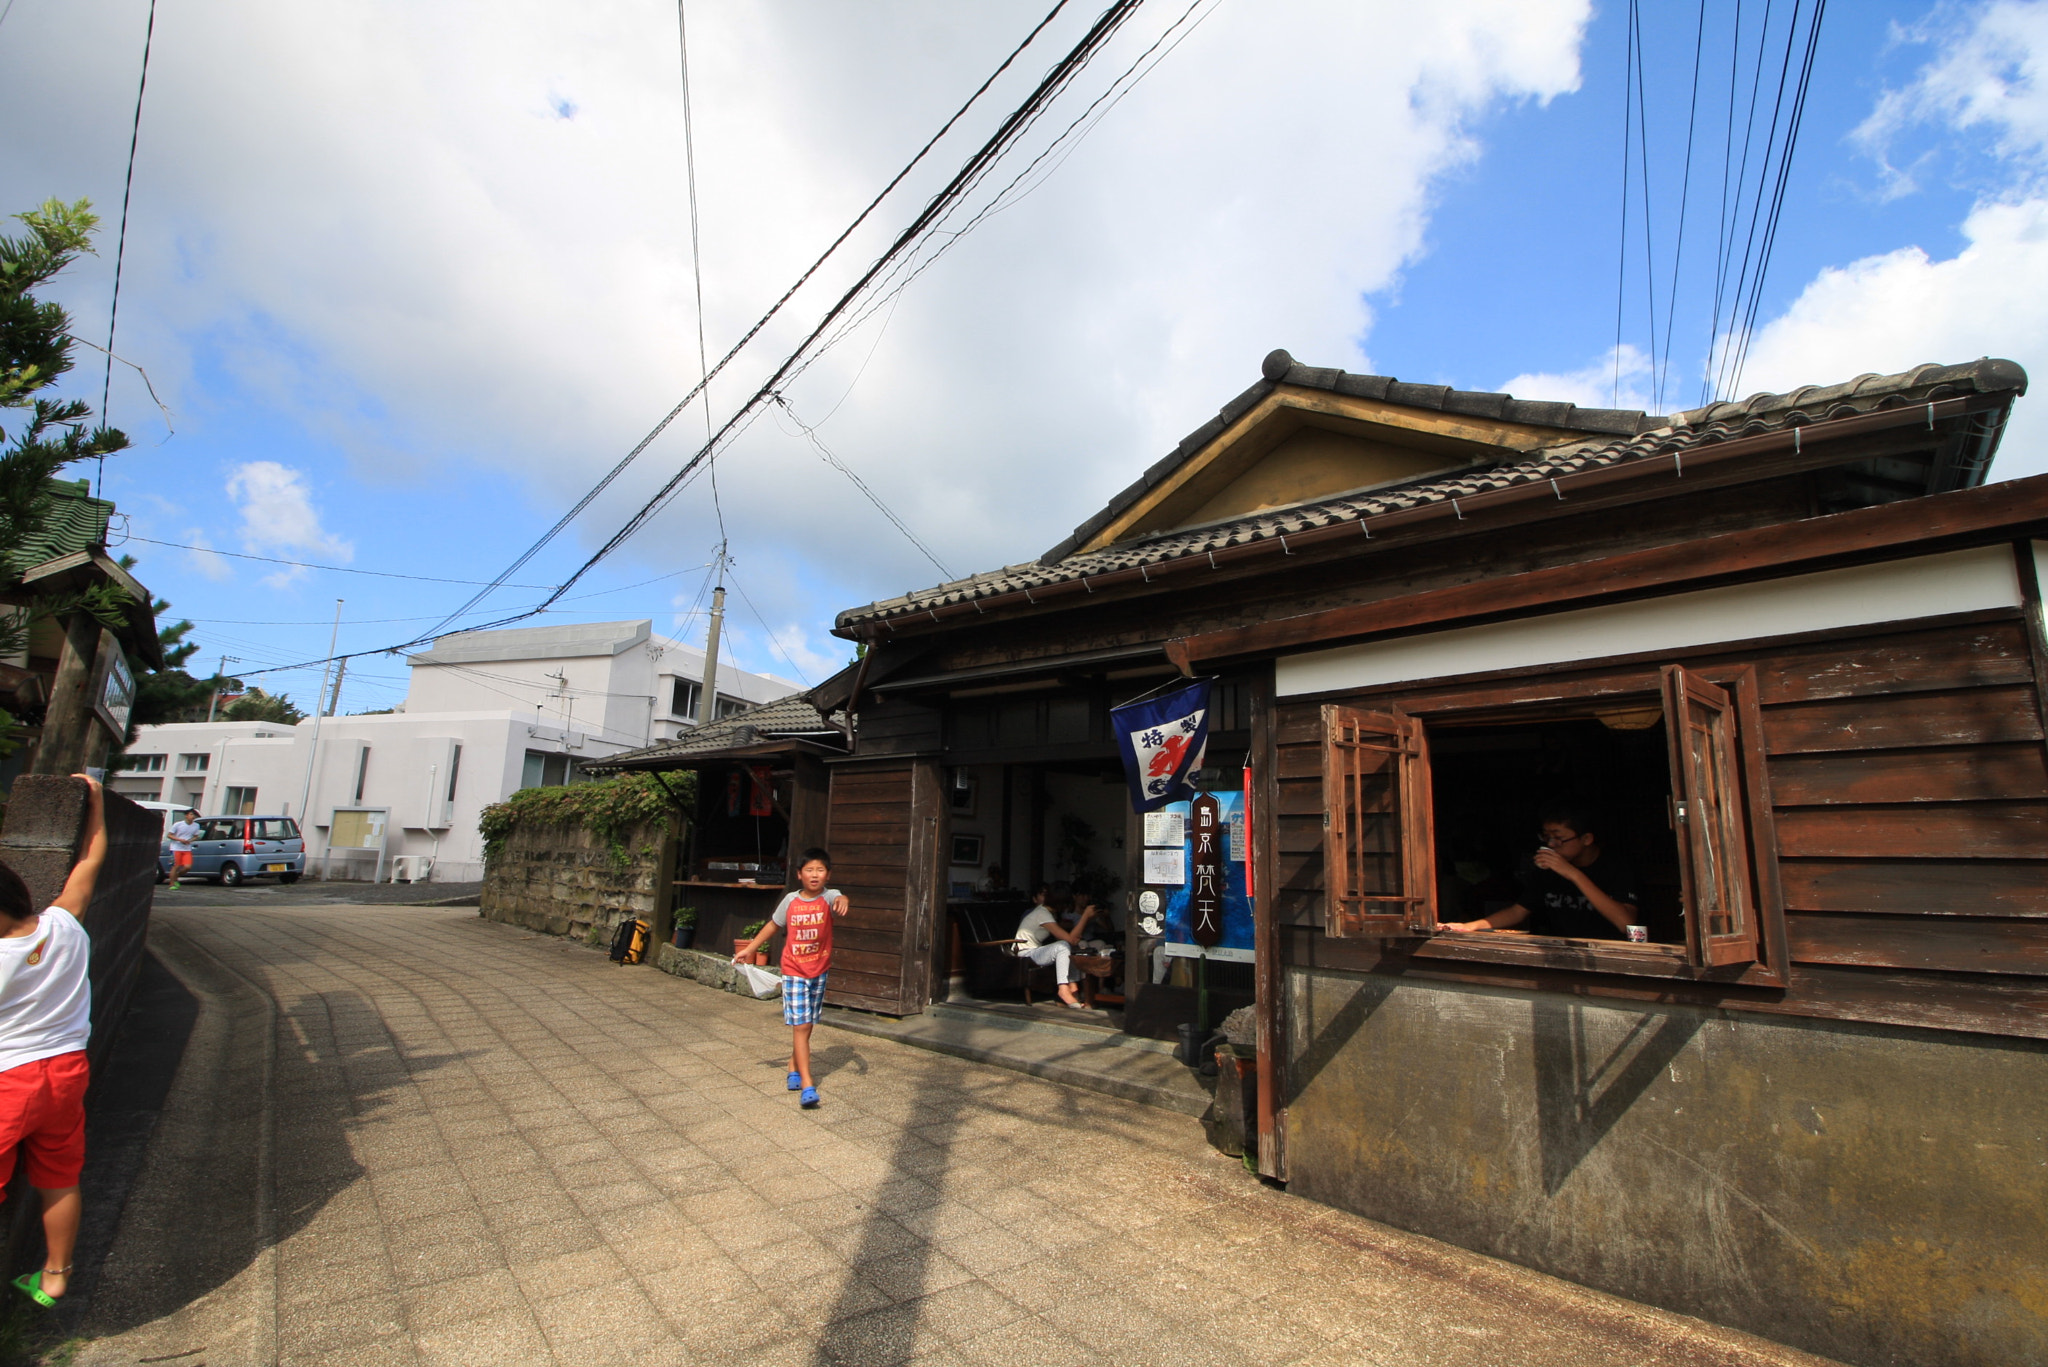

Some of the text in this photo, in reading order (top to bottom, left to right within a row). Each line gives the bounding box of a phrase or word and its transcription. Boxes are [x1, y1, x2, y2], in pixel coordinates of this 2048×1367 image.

[791, 912, 824, 926] SPEAK
[796, 928, 818, 941] AND
[791, 942, 820, 956] EYES
